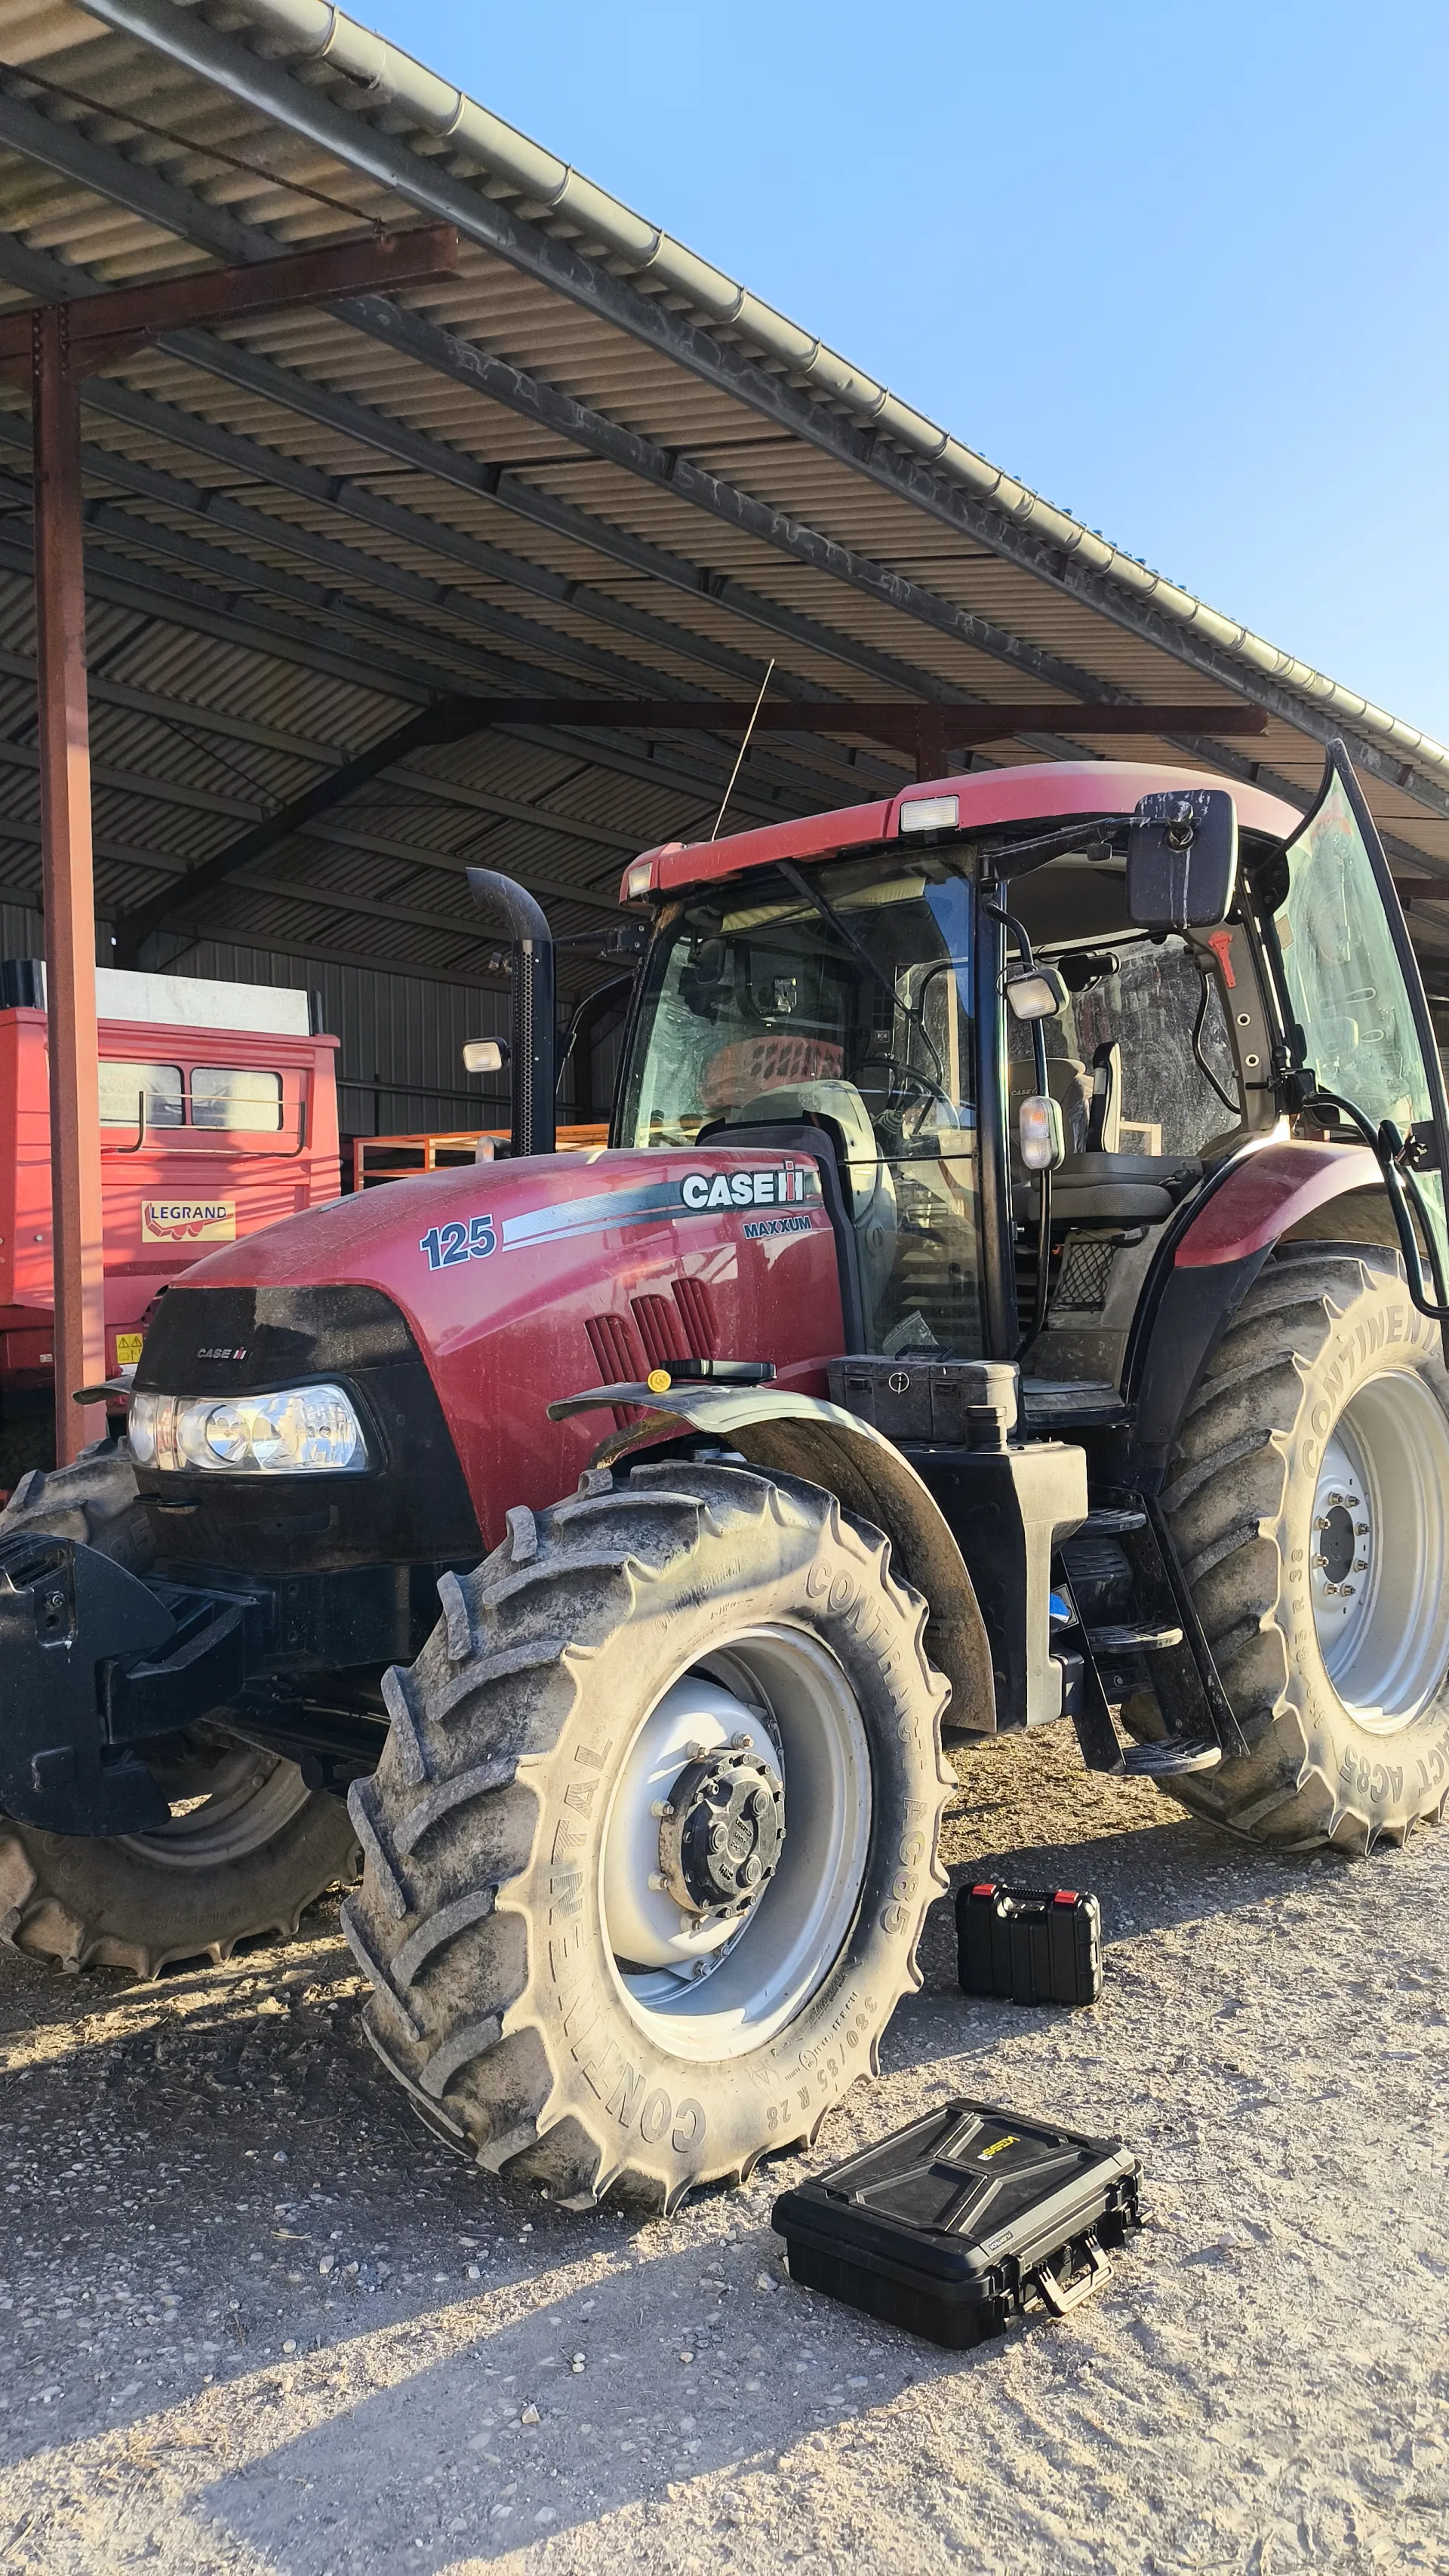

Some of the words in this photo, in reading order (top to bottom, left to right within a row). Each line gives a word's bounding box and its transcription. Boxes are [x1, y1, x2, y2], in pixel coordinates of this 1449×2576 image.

[682, 1173, 774, 1209] CASE
[151, 1207, 226, 1219] LEGRAND
[743, 1216, 812, 1239] MAXXUM
[420, 1215, 496, 1270] 125
[197, 1348, 232, 1359] CASE
[1289, 1549, 1303, 1583] 38
[1292, 1596, 1306, 1615] R
[1339, 1744, 1404, 1804] AC85
[882, 1797, 928, 1936] AC85
[817, 1996, 877, 2093] 380/85
[796, 2086, 811, 2110] R
[767, 2099, 791, 2131] 28
